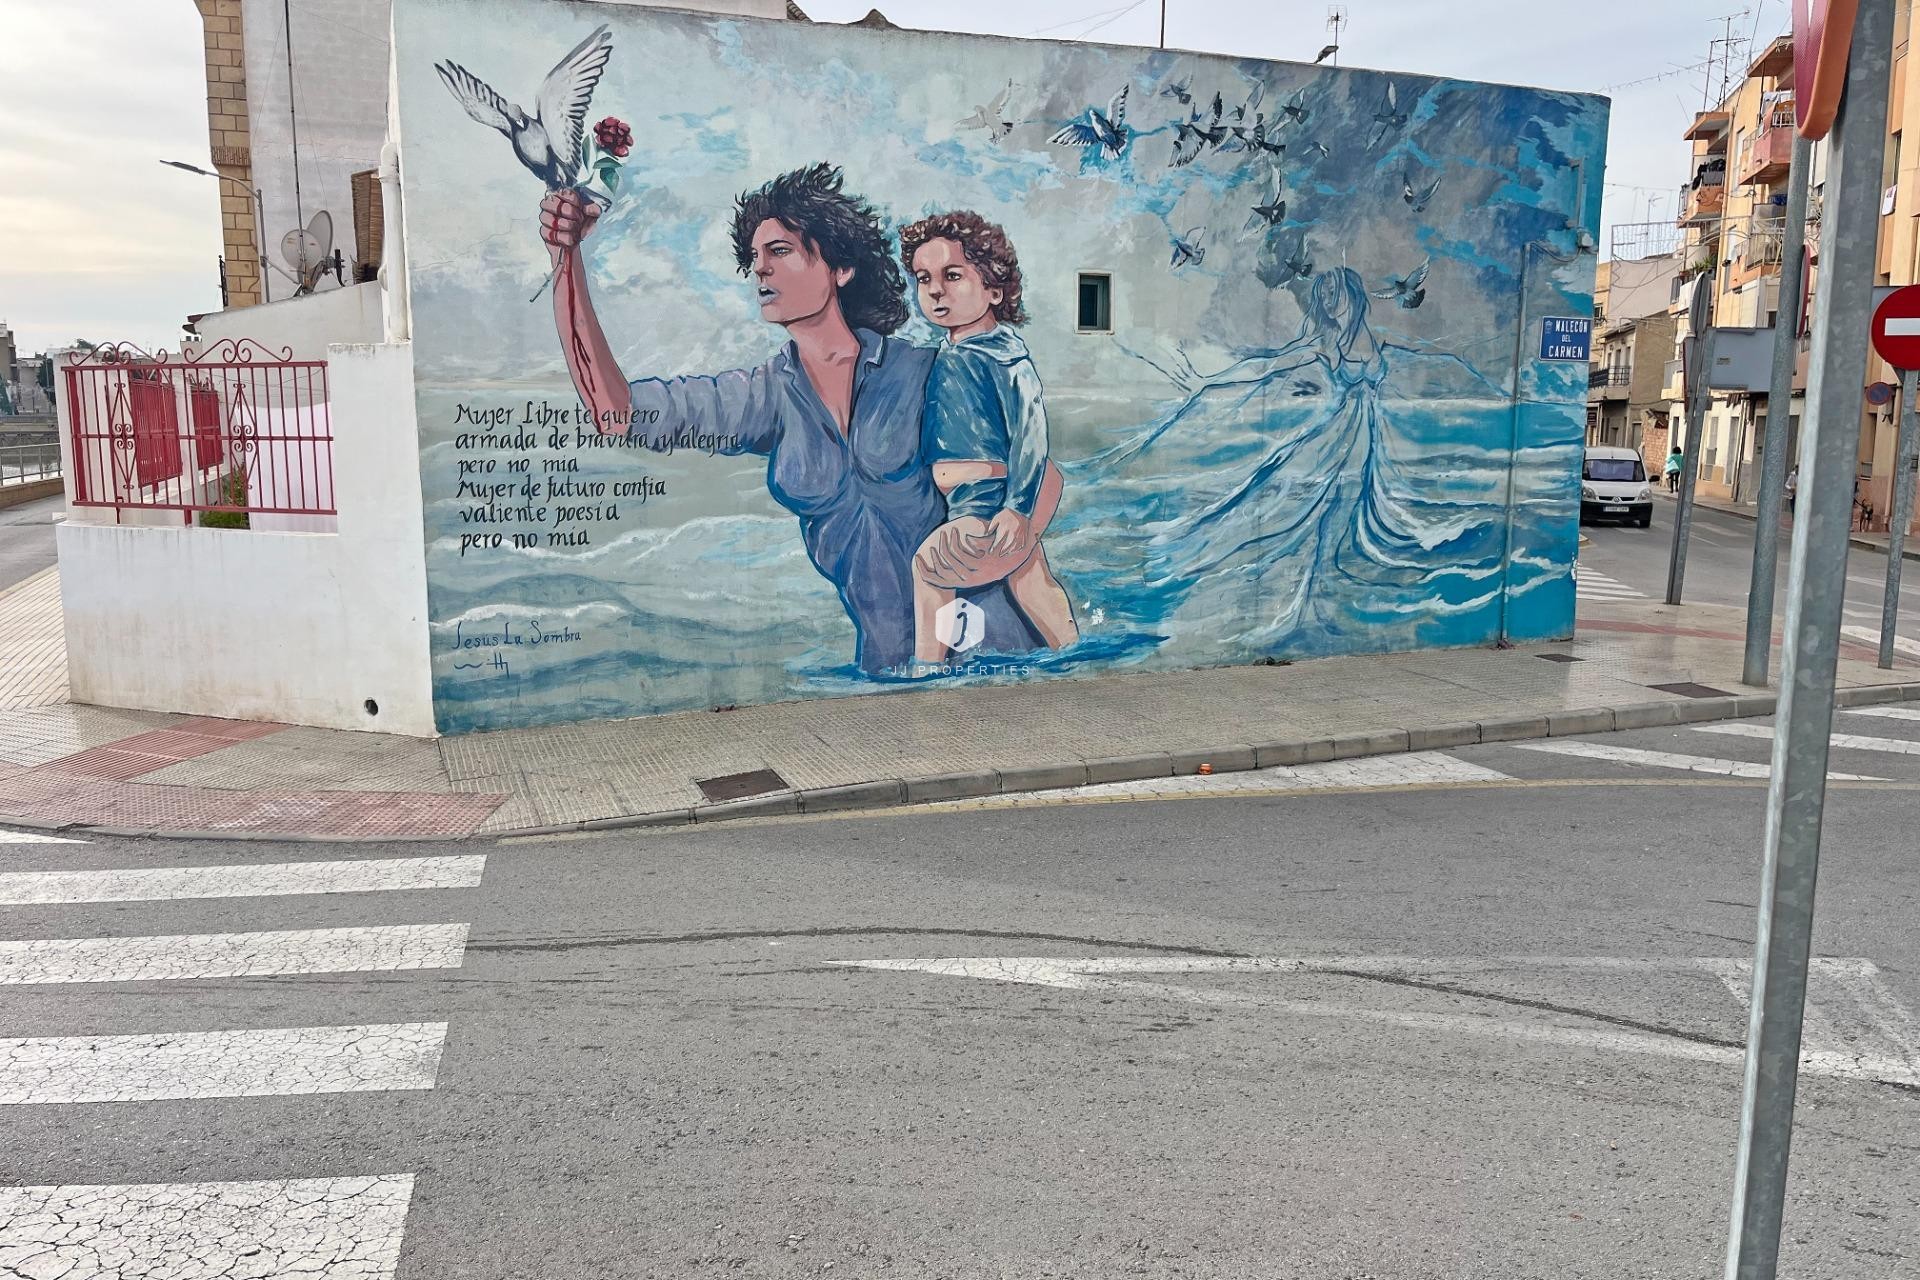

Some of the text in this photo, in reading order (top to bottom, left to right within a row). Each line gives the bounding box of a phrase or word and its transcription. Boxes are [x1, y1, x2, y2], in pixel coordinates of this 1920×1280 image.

[1561, 334, 1571, 342] DEL
[1548, 345, 1583, 358] CARMEN
[454, 401, 660, 432] Mujer Libre te quiero
[455, 424, 537, 451] armada
[548, 425, 569, 450] de
[575, 424, 651, 449] bravura
[660, 433, 674, 456] y
[457, 459, 497, 481] pero
[508, 458, 530, 473] no
[456, 479, 517, 505] Mujer
[520, 474, 542, 500] de
[547, 475, 606, 503] futuro
[459, 500, 621, 528] valiente poesía
[460, 531, 502, 557] pero
[512, 532, 539, 549] no
[503, 621, 524, 645] La
